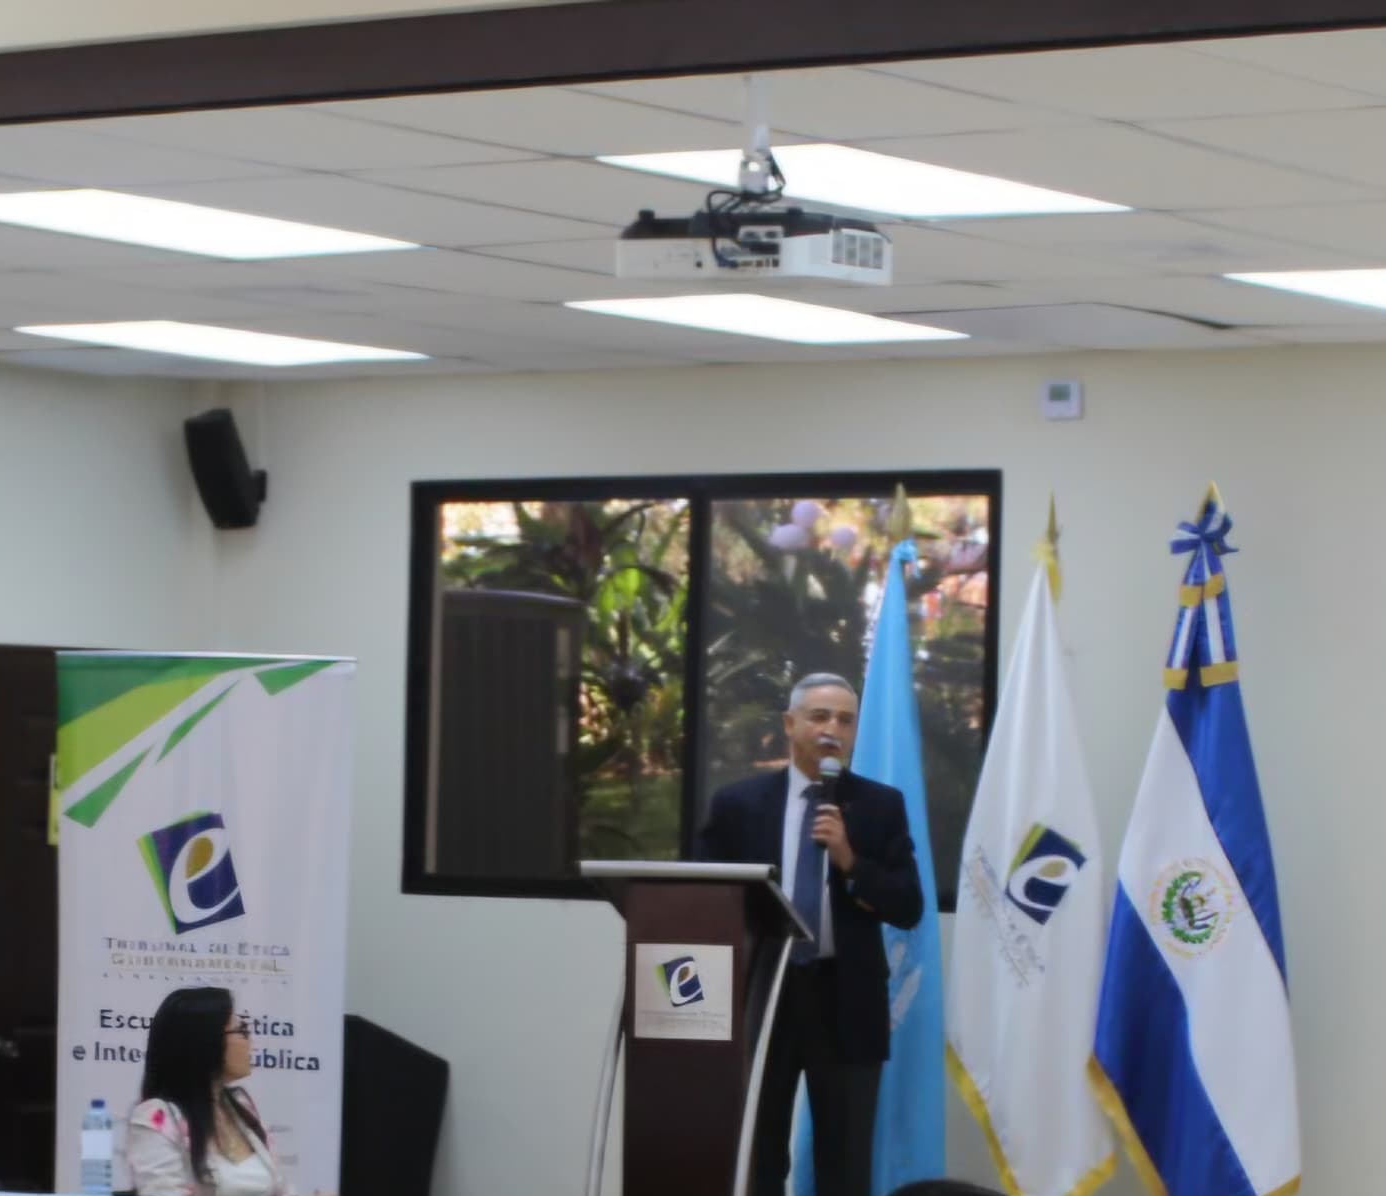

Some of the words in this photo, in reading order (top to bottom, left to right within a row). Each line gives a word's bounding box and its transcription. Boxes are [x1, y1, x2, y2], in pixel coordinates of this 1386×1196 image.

[99, 1008, 152, 1030] Escu
[71, 1044, 87, 1061] e
[248, 1047, 321, 1071] ública
